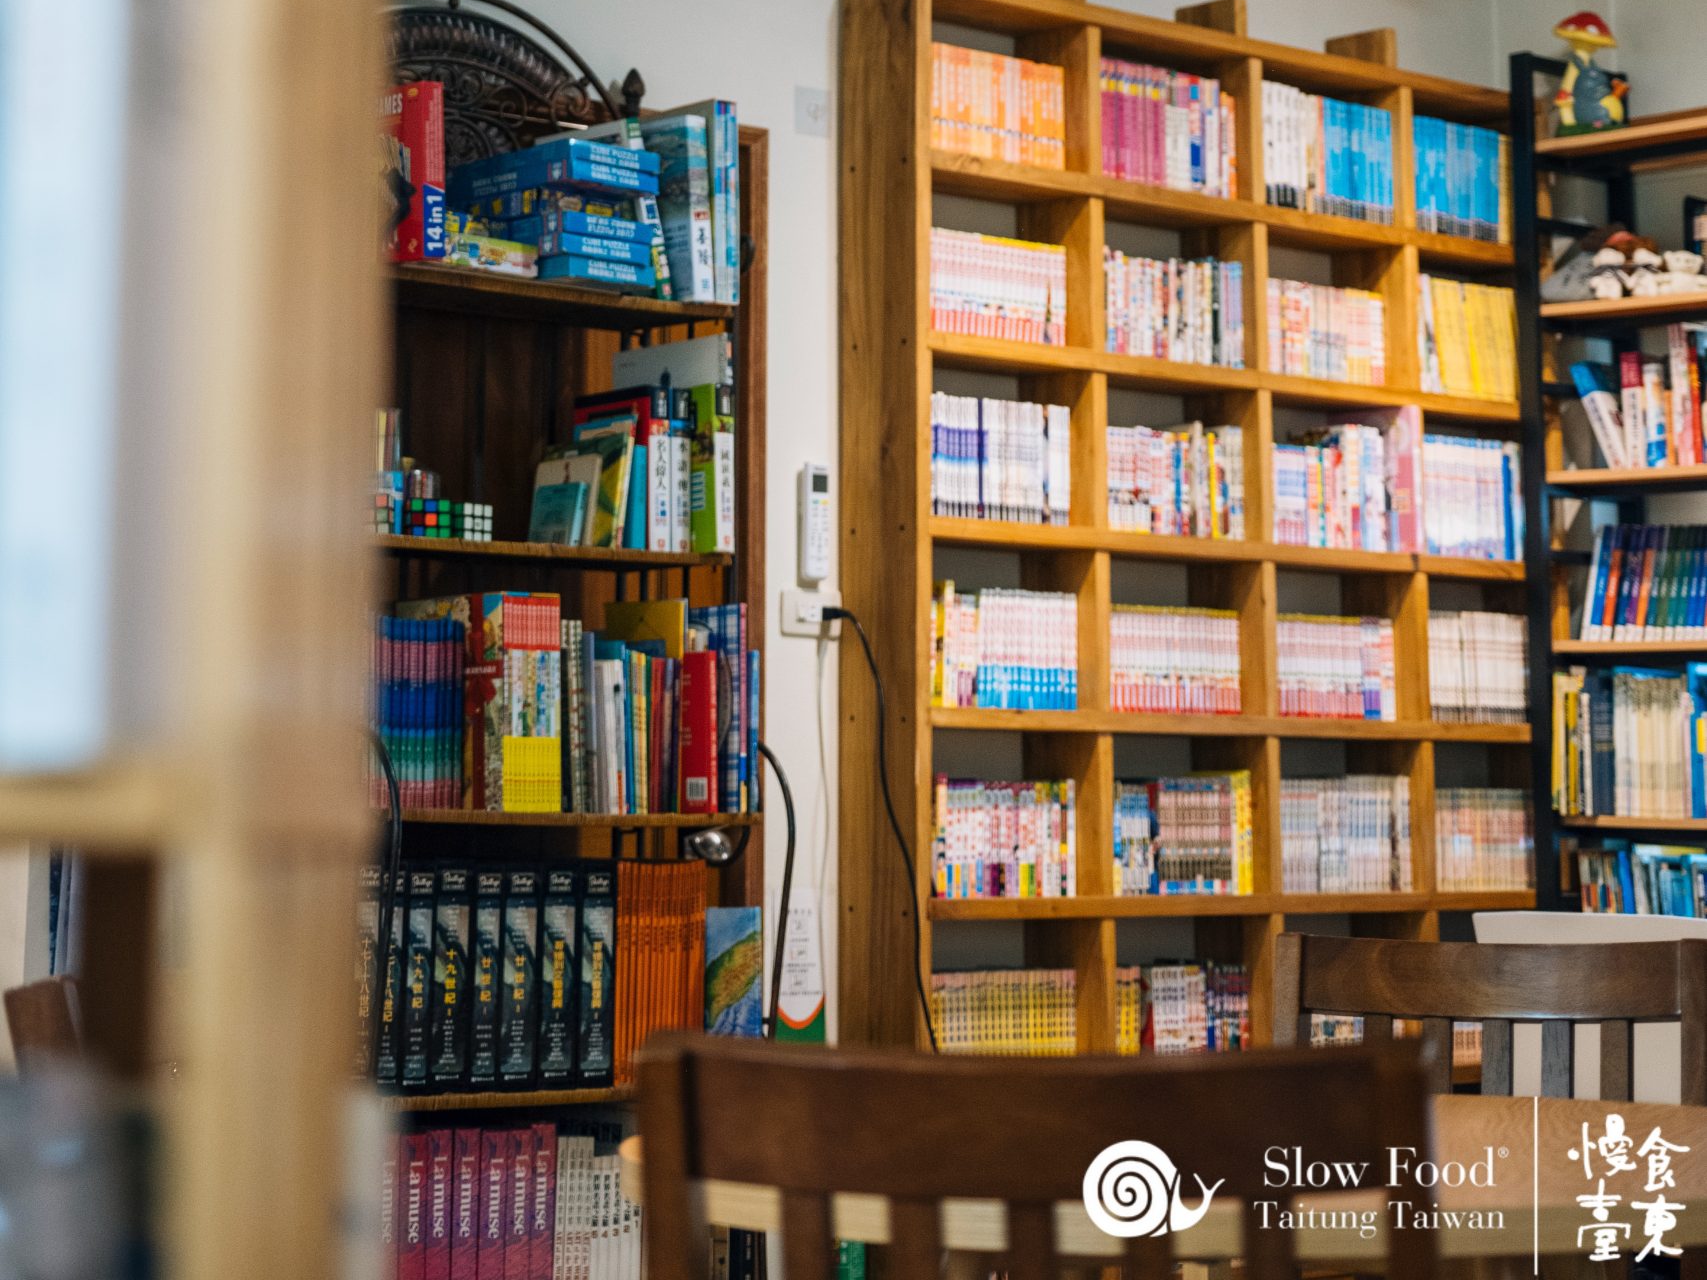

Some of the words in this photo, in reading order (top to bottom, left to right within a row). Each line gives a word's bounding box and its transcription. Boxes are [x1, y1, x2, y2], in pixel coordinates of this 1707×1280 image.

[426, 194, 443, 205] 1
[428, 206, 443, 224] in
[426, 227, 443, 252] 14
[408, 1188, 420, 1244] muse
[432, 1183, 445, 1239] muse
[459, 1183, 472, 1238] muse
[488, 1184, 500, 1239] muse
[513, 1180, 526, 1235] muse
[534, 1176, 547, 1231] muse
